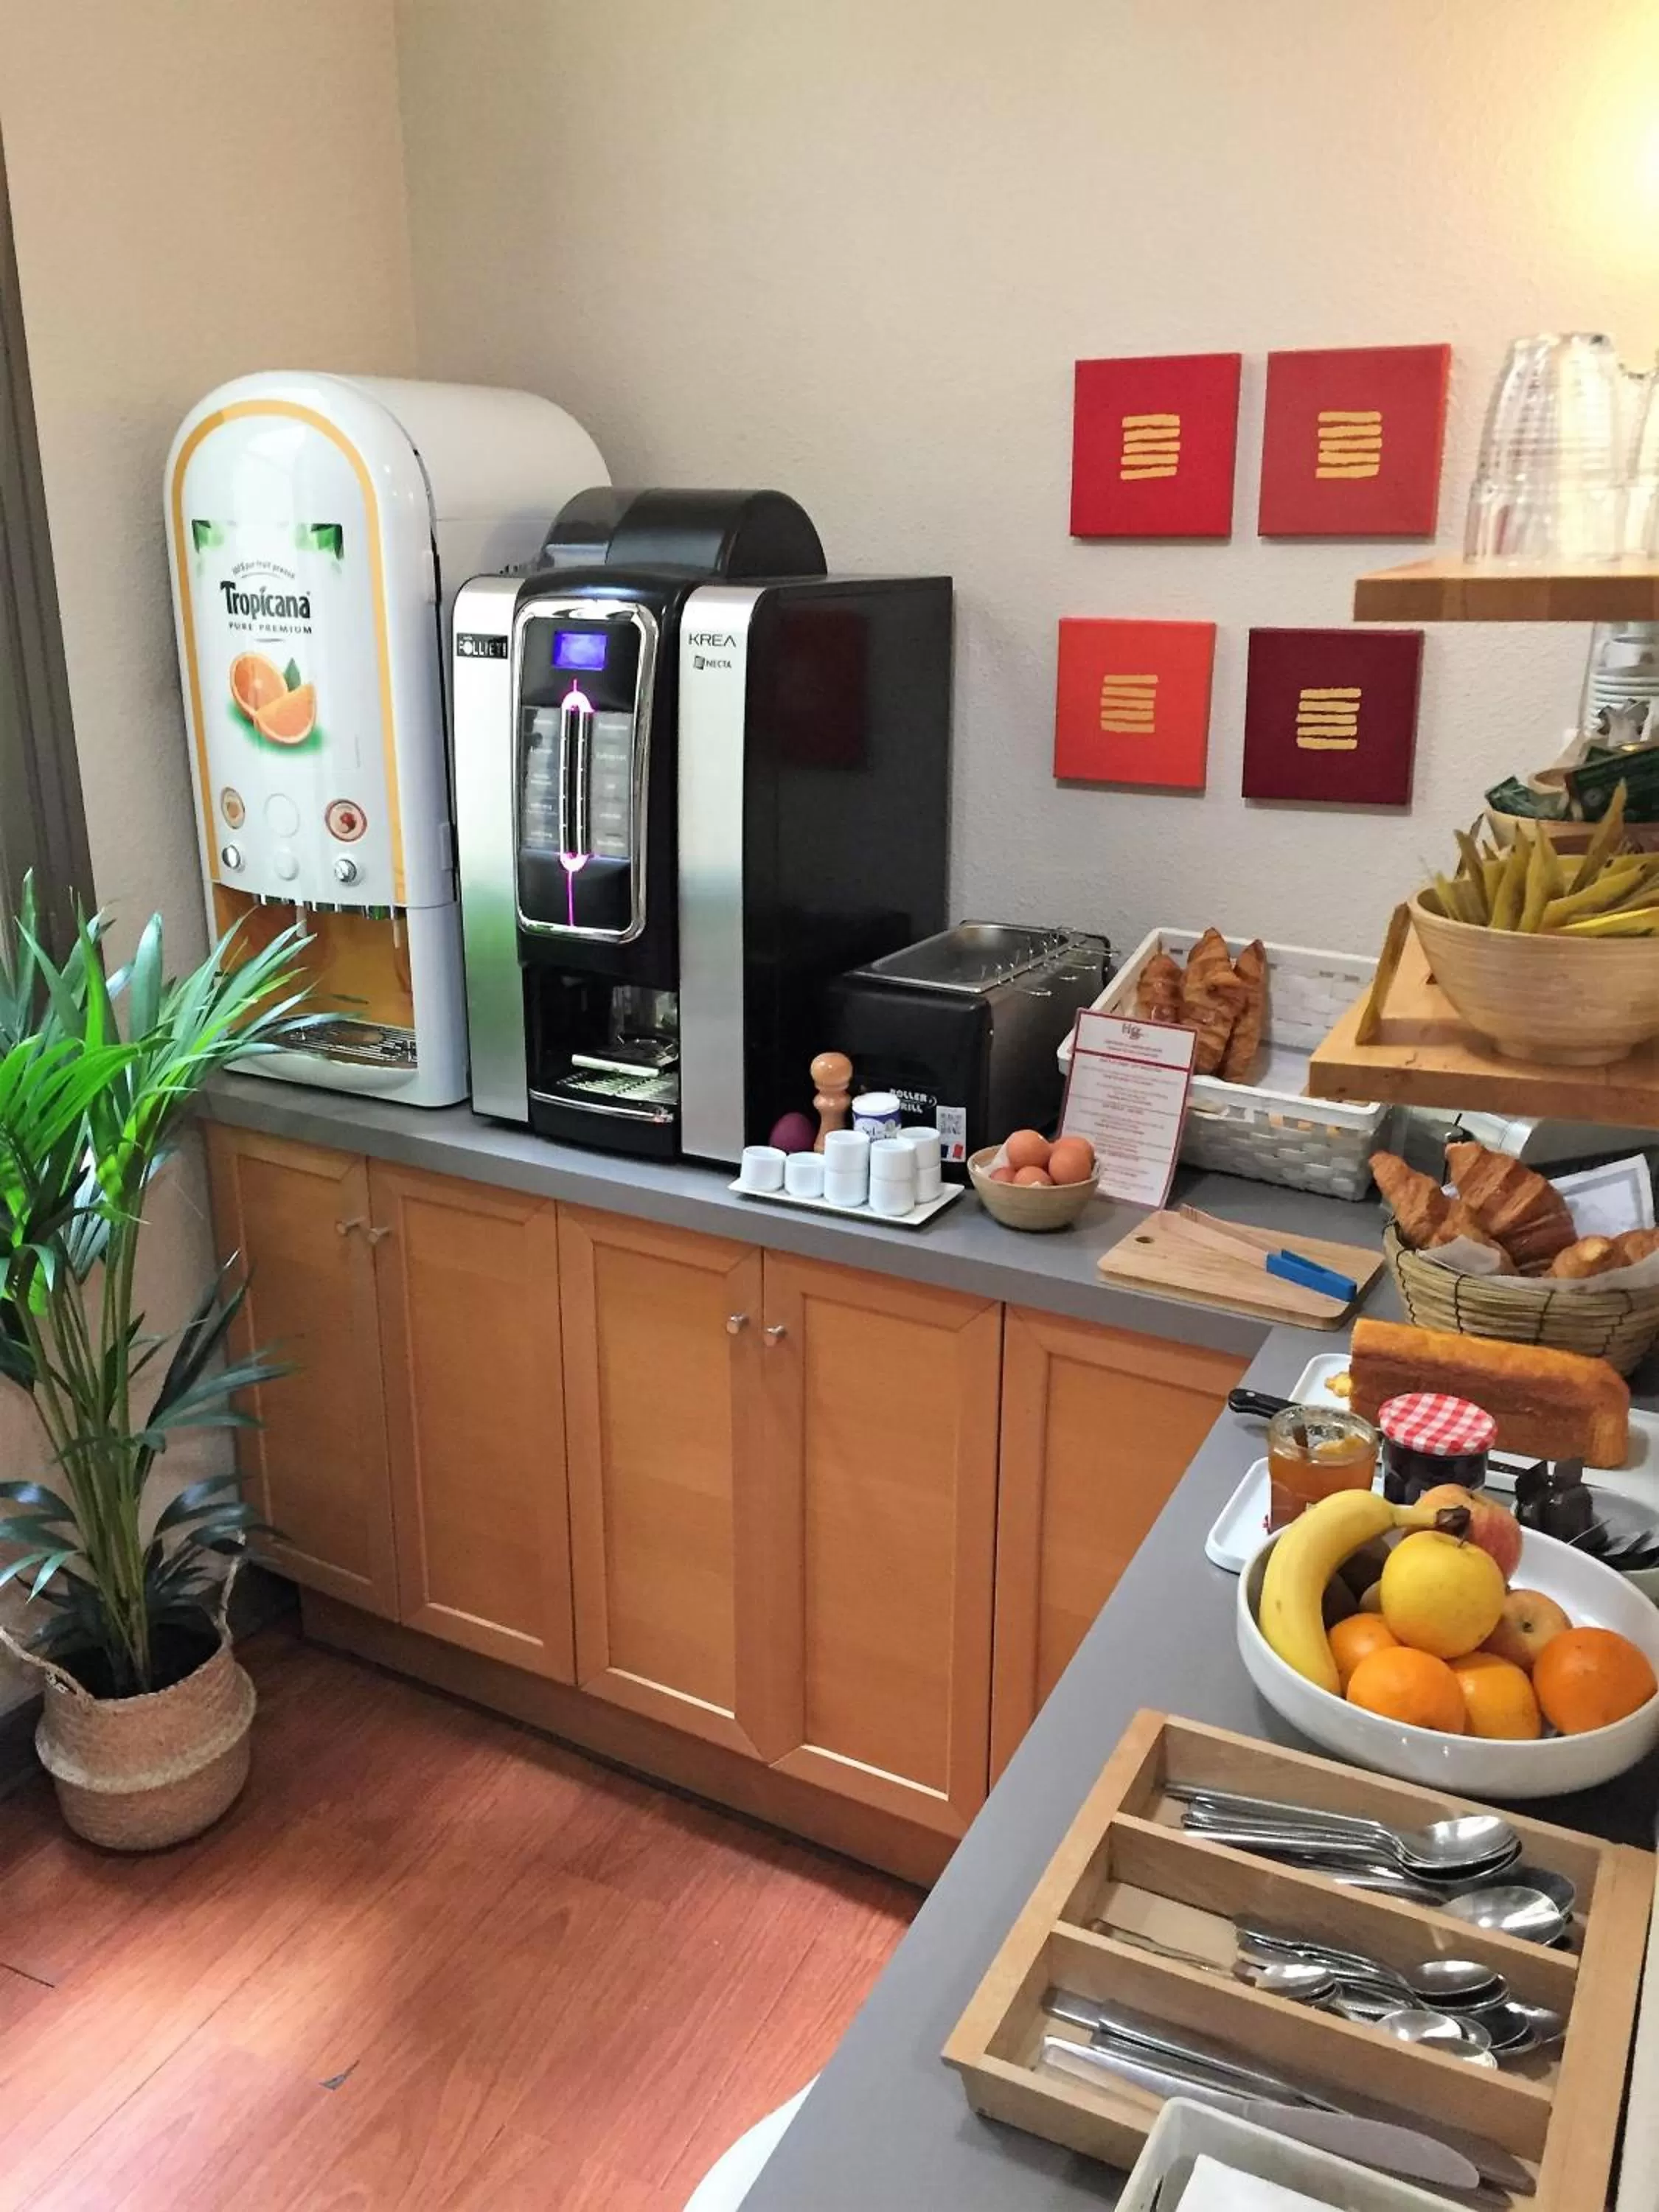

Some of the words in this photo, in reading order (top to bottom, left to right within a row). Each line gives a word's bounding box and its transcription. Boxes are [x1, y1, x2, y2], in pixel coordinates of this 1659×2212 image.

[220, 580, 311, 620] Tropicana
[258, 624, 313, 634] PREMIUM
[689, 633, 737, 647] KREA
[900, 1102, 923, 1114] RILL
